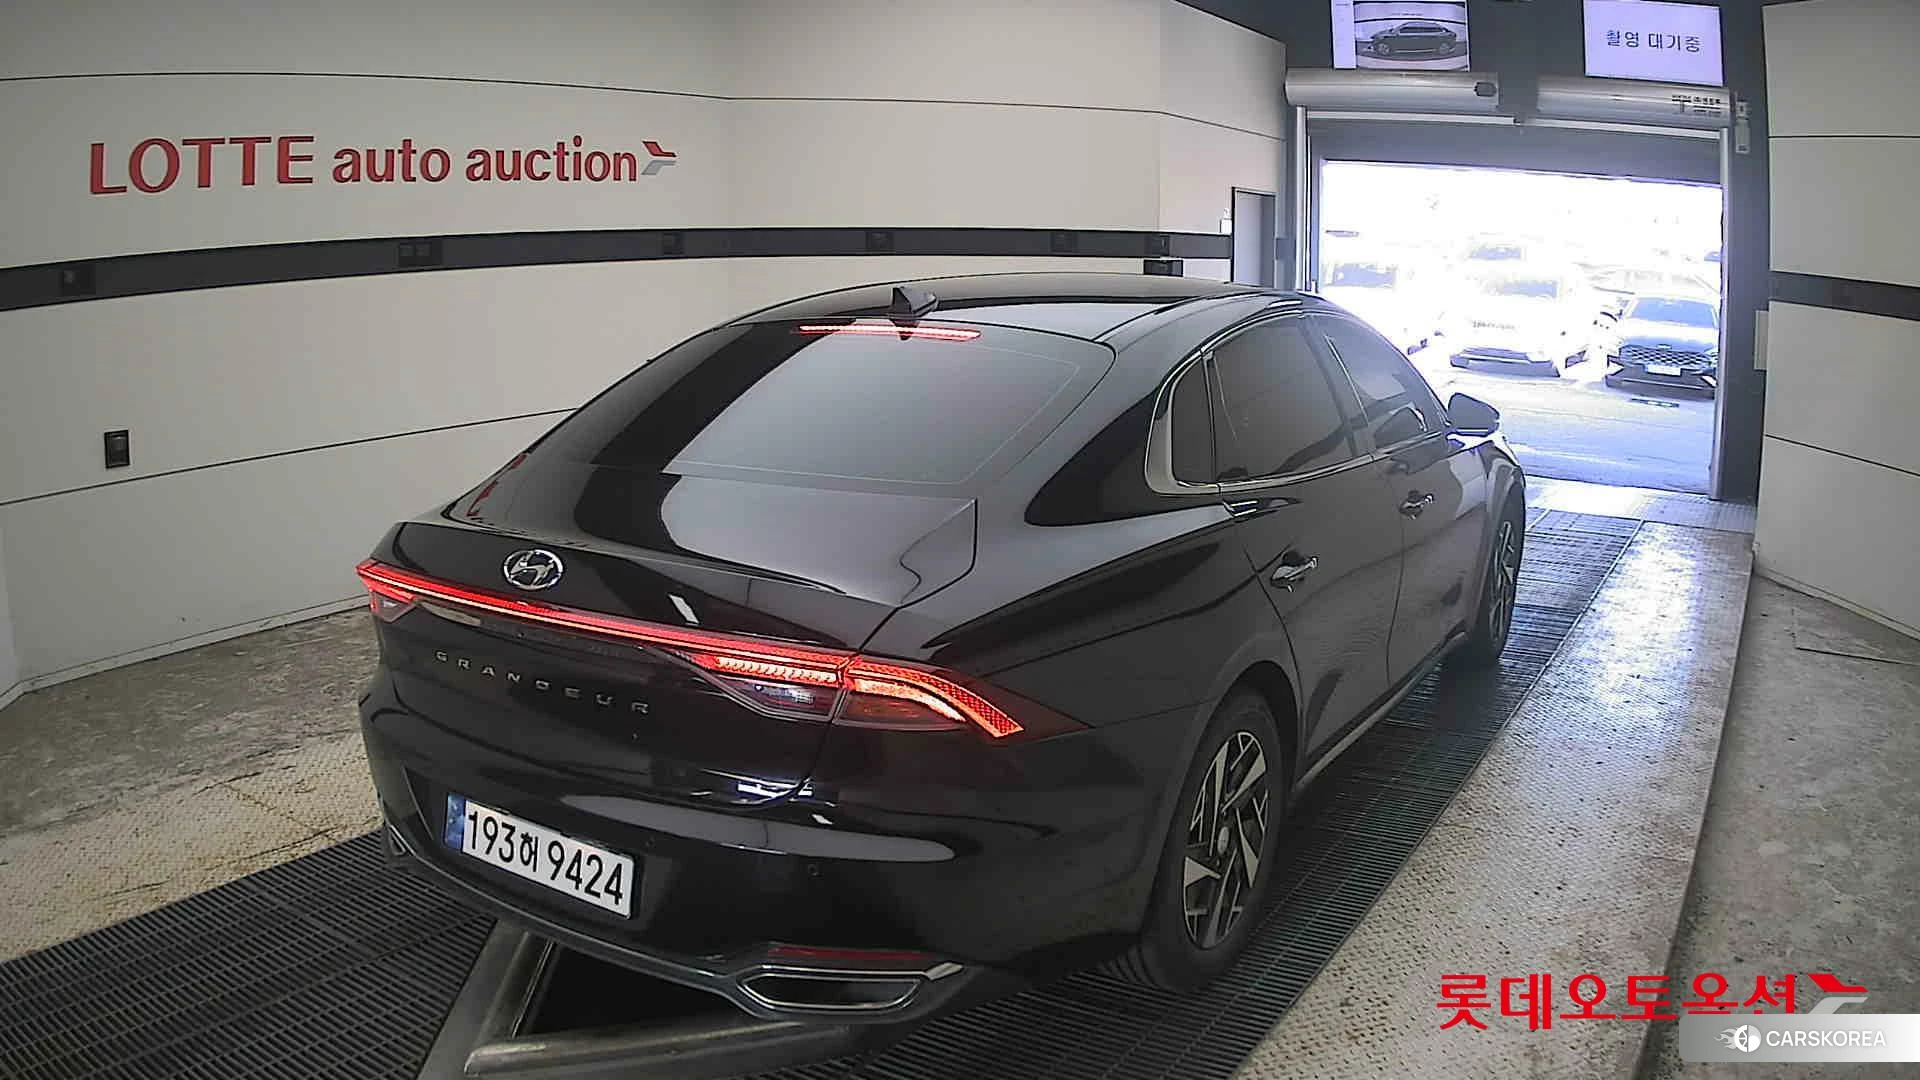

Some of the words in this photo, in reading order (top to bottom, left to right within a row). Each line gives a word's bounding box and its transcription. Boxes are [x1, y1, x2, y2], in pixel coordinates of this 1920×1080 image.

[1648, 32, 1701, 53] 대기중
[90, 136, 315, 195] LOTTE
[332, 138, 451, 183] auto
[464, 135, 638, 182] auction
[435, 650, 649, 715] GRANDEUR
[468, 810, 539, 873] 193허
[547, 839, 624, 905] 9424
